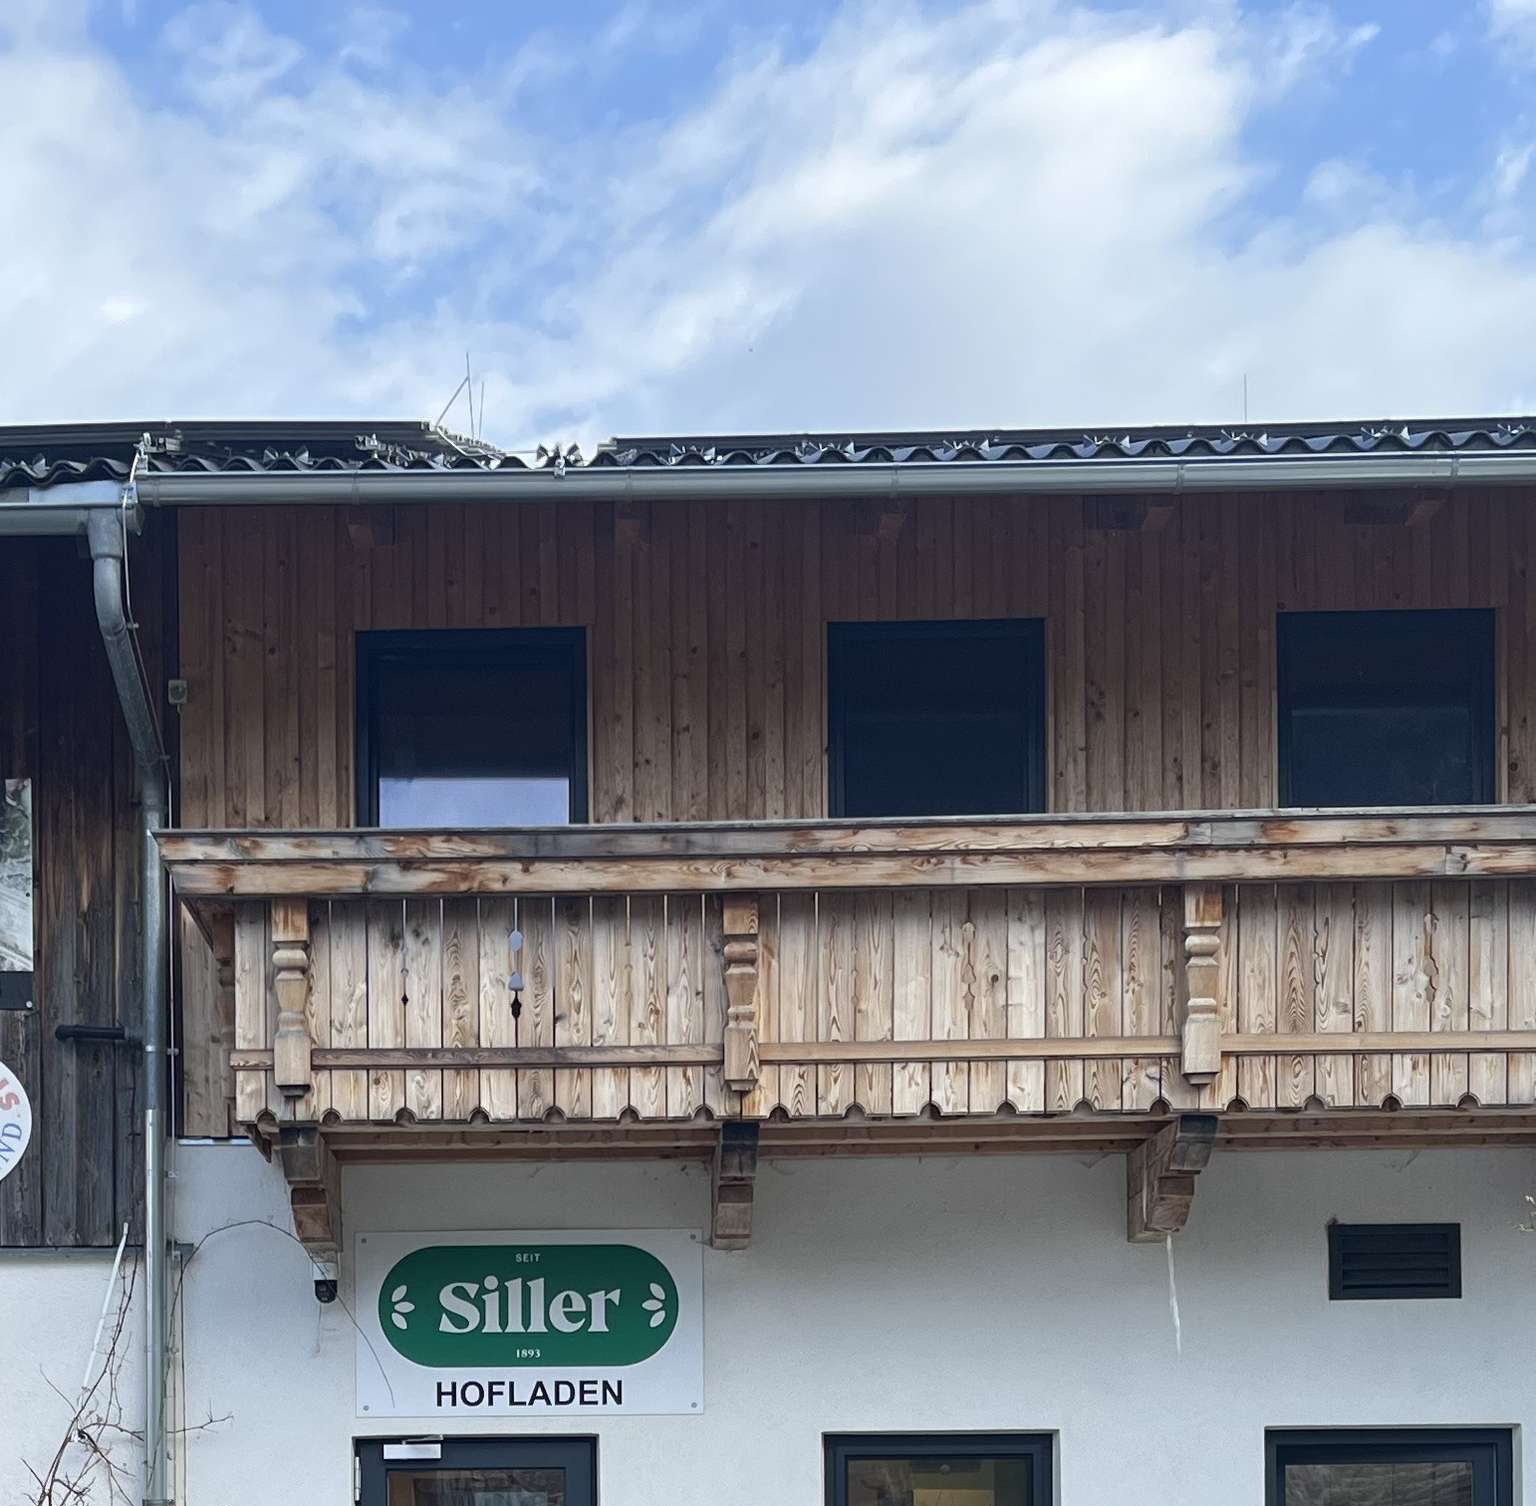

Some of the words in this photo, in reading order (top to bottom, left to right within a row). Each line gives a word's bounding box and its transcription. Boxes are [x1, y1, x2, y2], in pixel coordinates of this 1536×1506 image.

[515, 1252, 541, 1263] SEIT
[438, 1275, 621, 1334] Siller
[515, 1348, 541, 1359] 1893
[436, 1380, 623, 1407] HOFLADEN
